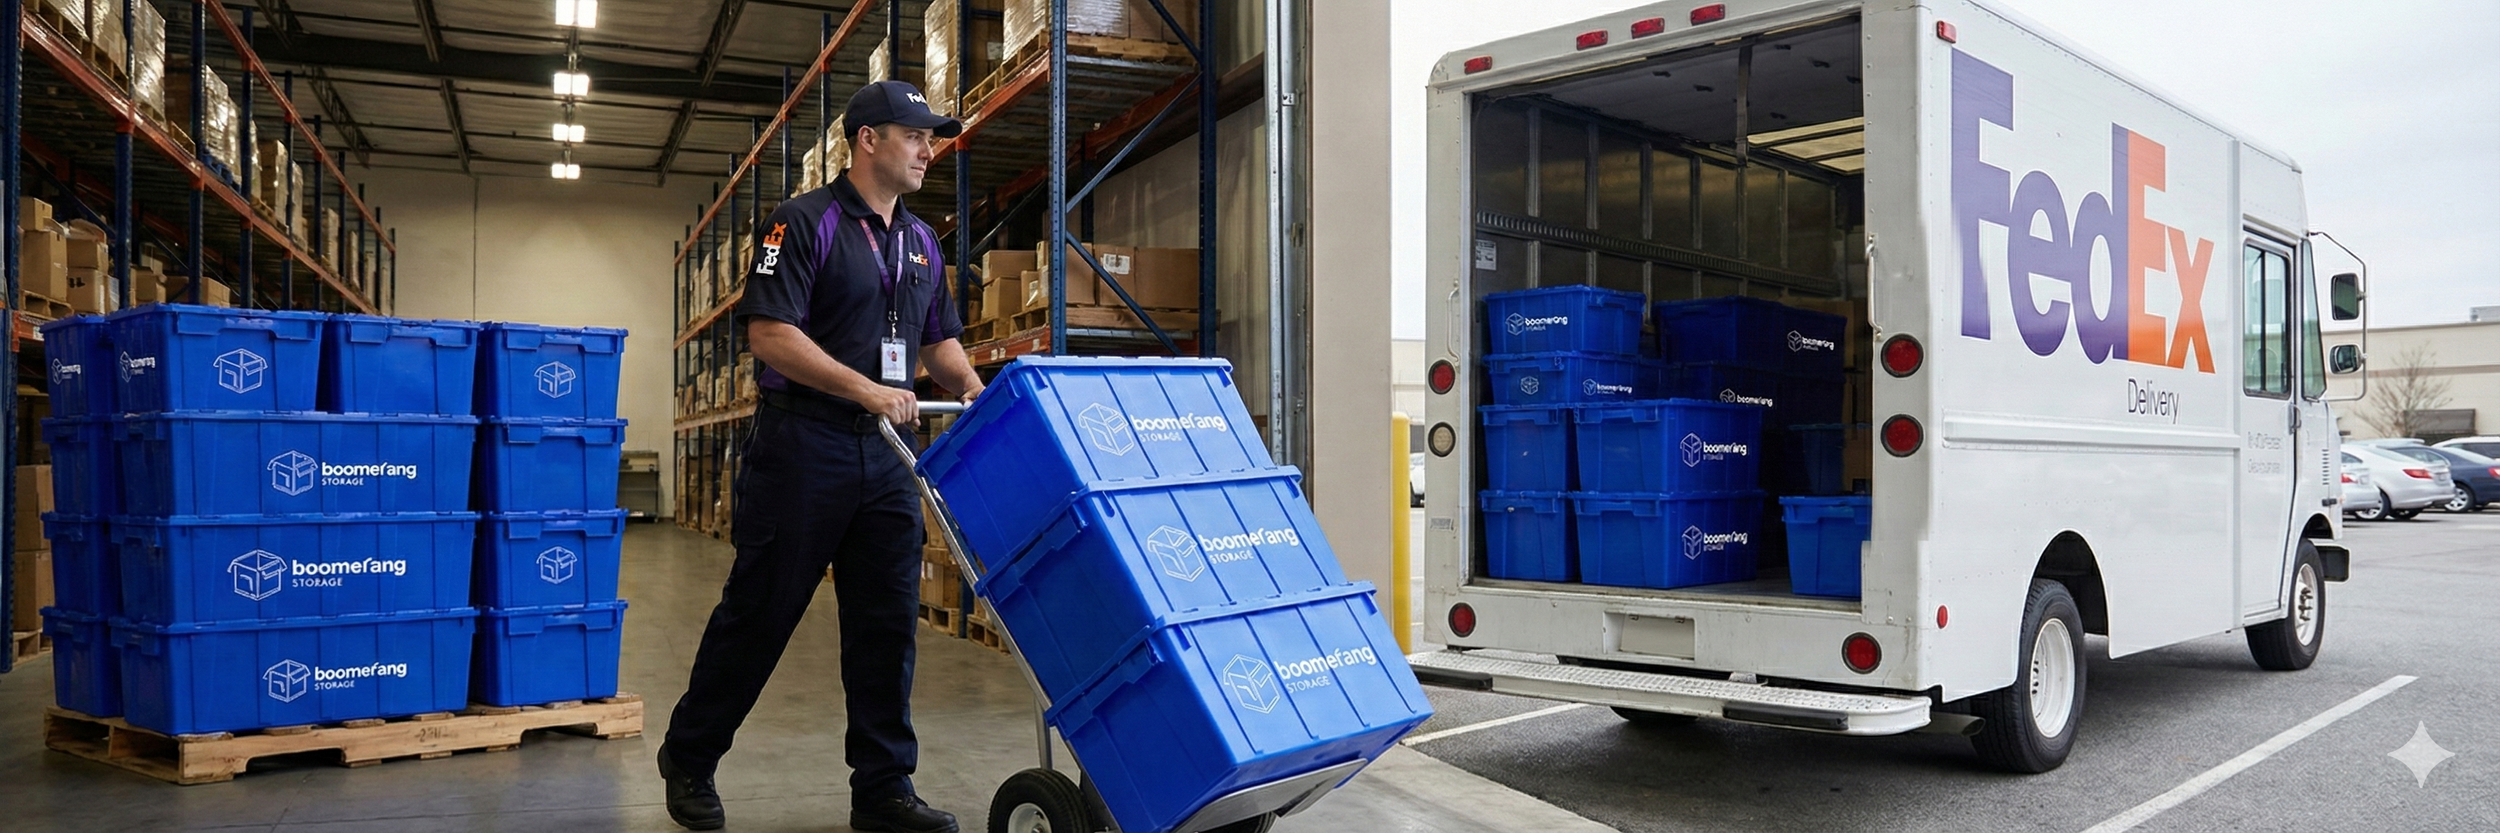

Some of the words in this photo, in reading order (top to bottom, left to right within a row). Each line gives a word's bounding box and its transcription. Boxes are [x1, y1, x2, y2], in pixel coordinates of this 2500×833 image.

[1951, 46, 2216, 374] FedEx
[756, 222, 787, 275] FedEx
[2128, 378, 2179, 424] Delivery
[1130, 413, 1227, 432] boomerang
[322, 462, 417, 479] boomerang
[322, 478, 364, 486] STORAGE
[1198, 528, 1300, 552] boomerang
[292, 557, 407, 576] boomerang
[1209, 550, 1254, 564] STORAGE
[292, 577, 343, 587] STORAGE
[314, 662, 408, 681] boomerang
[1274, 645, 1377, 680] boomerang
[1286, 675, 1331, 694] STORAGE
